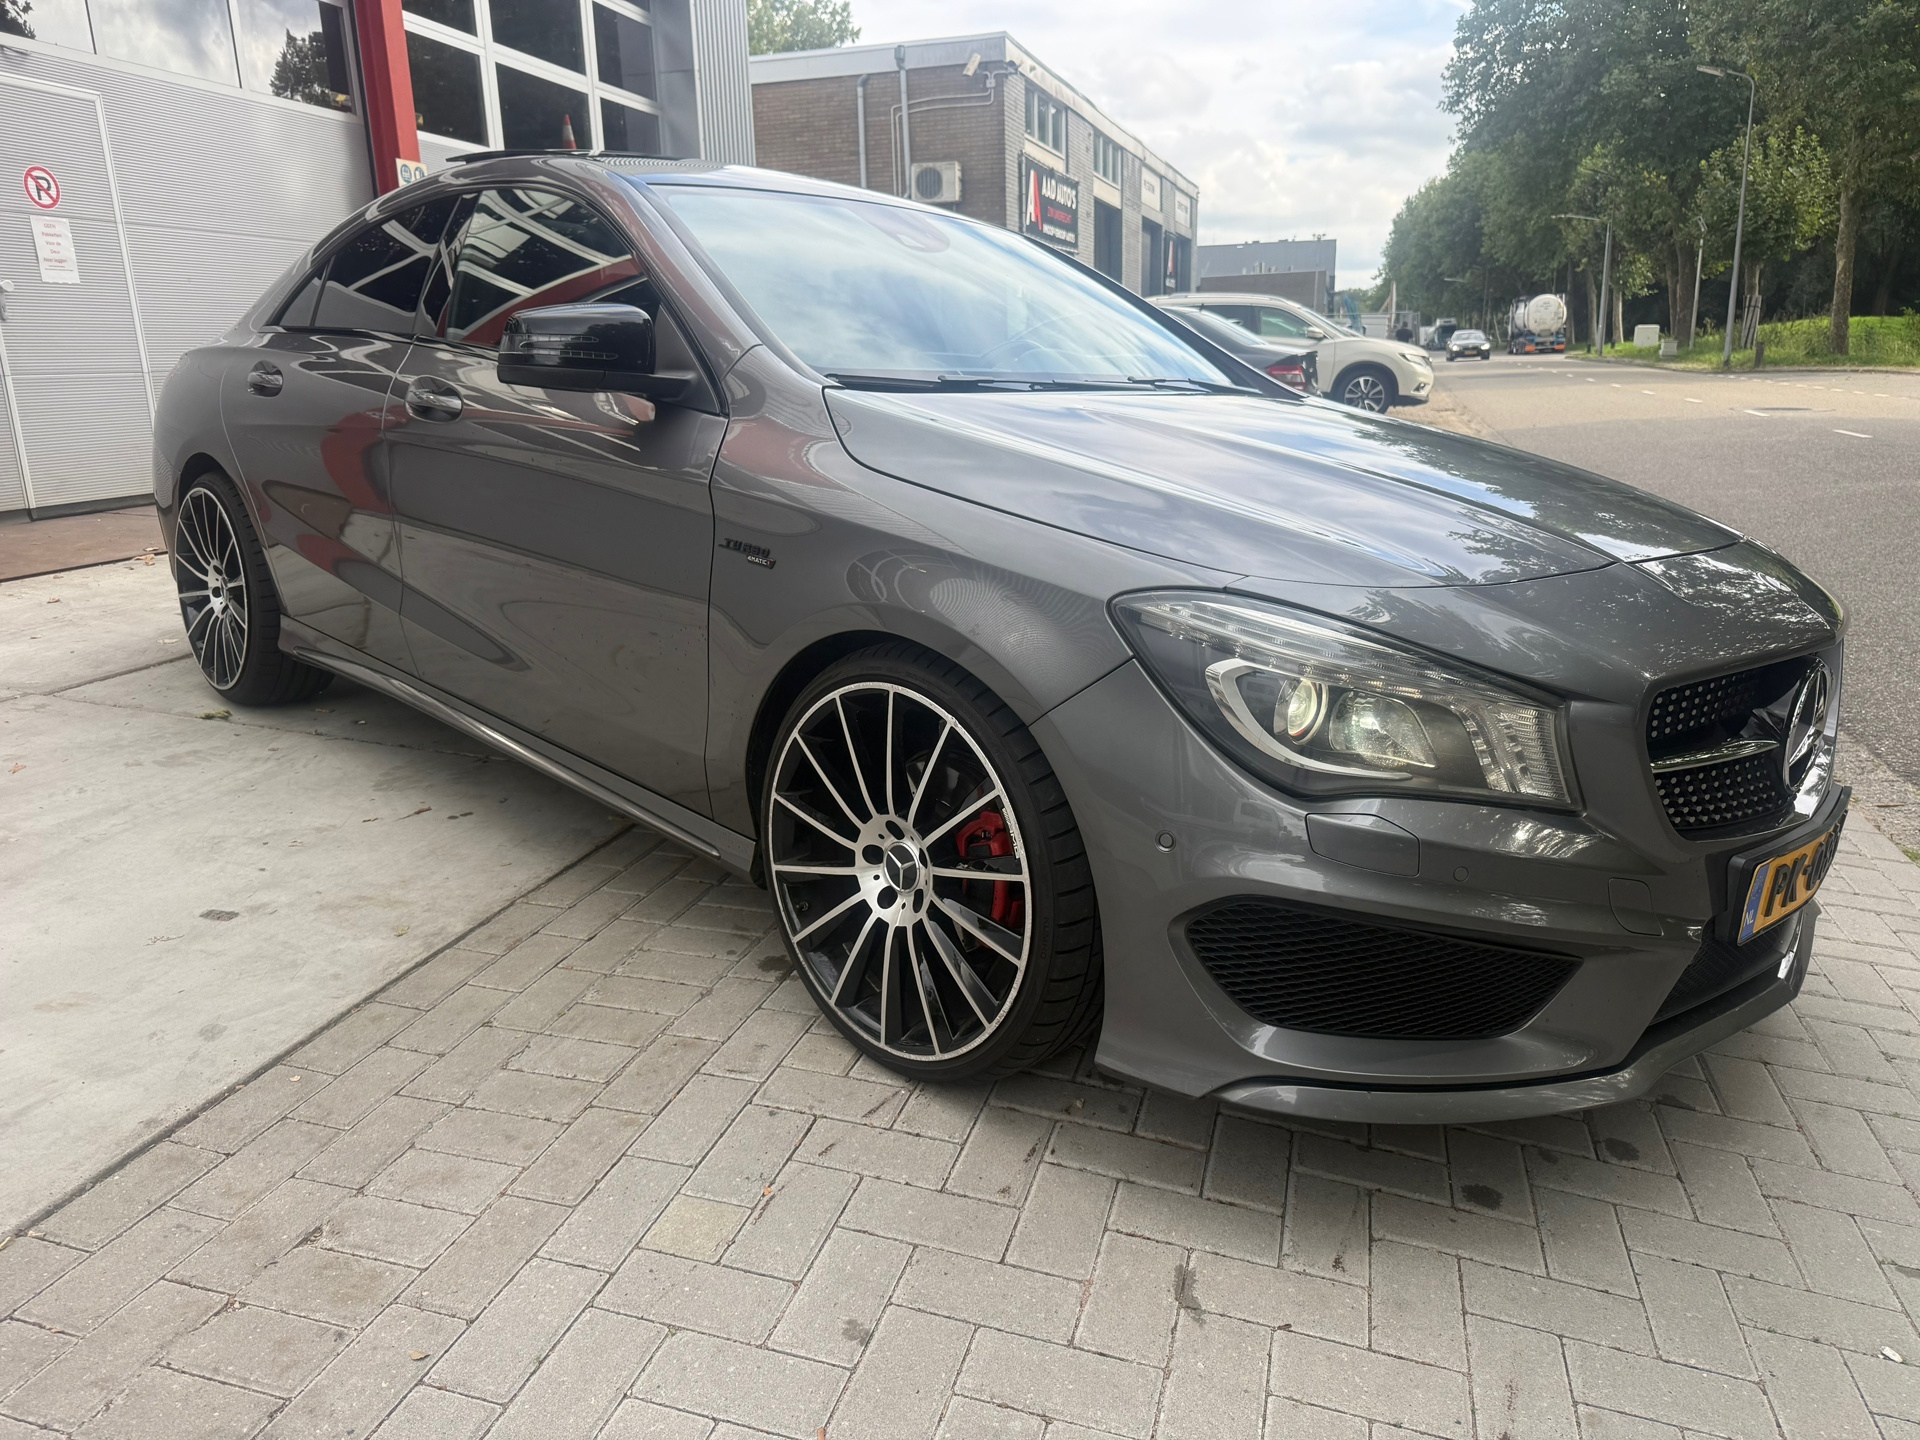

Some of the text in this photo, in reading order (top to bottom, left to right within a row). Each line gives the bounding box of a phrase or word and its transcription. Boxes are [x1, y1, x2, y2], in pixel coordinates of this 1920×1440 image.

[1041, 174, 1057, 200] AAD
[718, 537, 771, 558] TURBO
[1039, 916, 1050, 961] KUMHO
